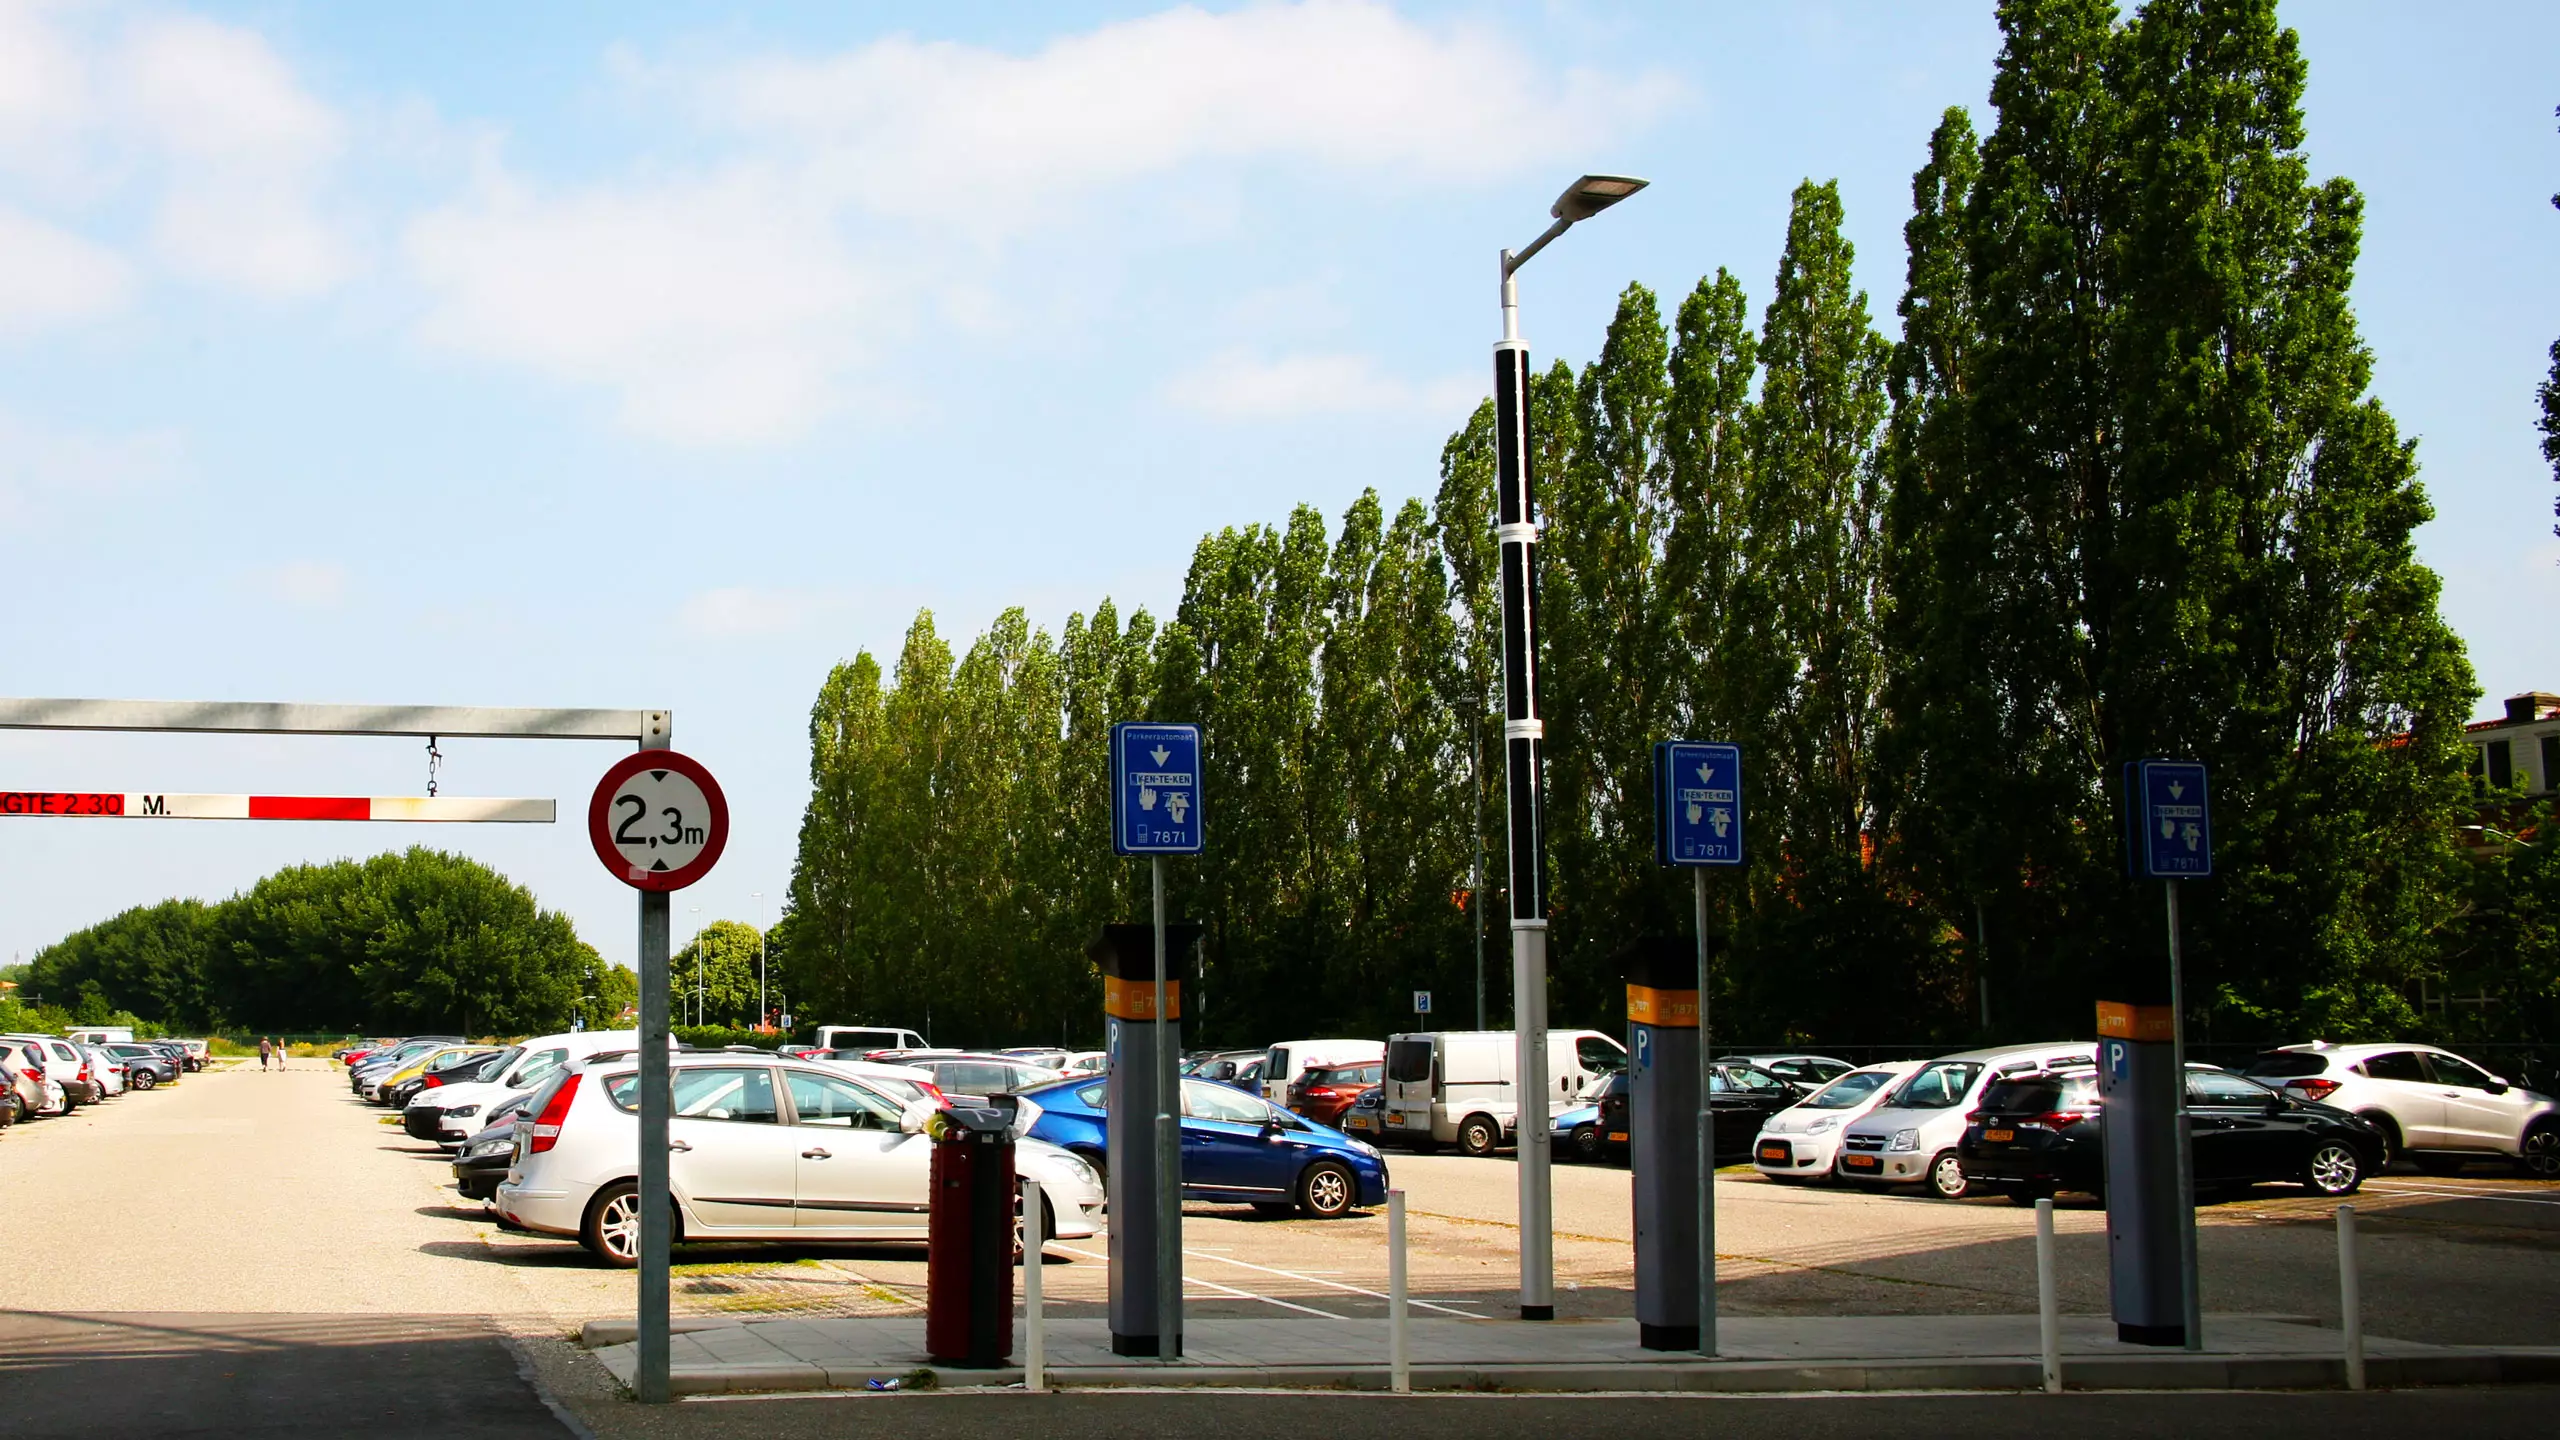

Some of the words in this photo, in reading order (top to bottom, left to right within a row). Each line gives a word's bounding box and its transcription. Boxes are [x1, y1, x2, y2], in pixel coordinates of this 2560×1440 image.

[1138, 774, 1190, 785] KEN-TE-KEN
[1685, 789, 1732, 801] KEN-TE-KEN
[63, 794, 122, 815] 2.30
[143, 795, 171, 815] M.
[615, 794, 704, 849] 2,3m
[1153, 831, 1185, 843] 7871
[1698, 844, 1728, 856] 7871
[2171, 857, 2199, 870] 7871
[1111, 1023, 1118, 1053] P
[1637, 1029, 1647, 1059] P
[2111, 1043, 2124, 1072] P
